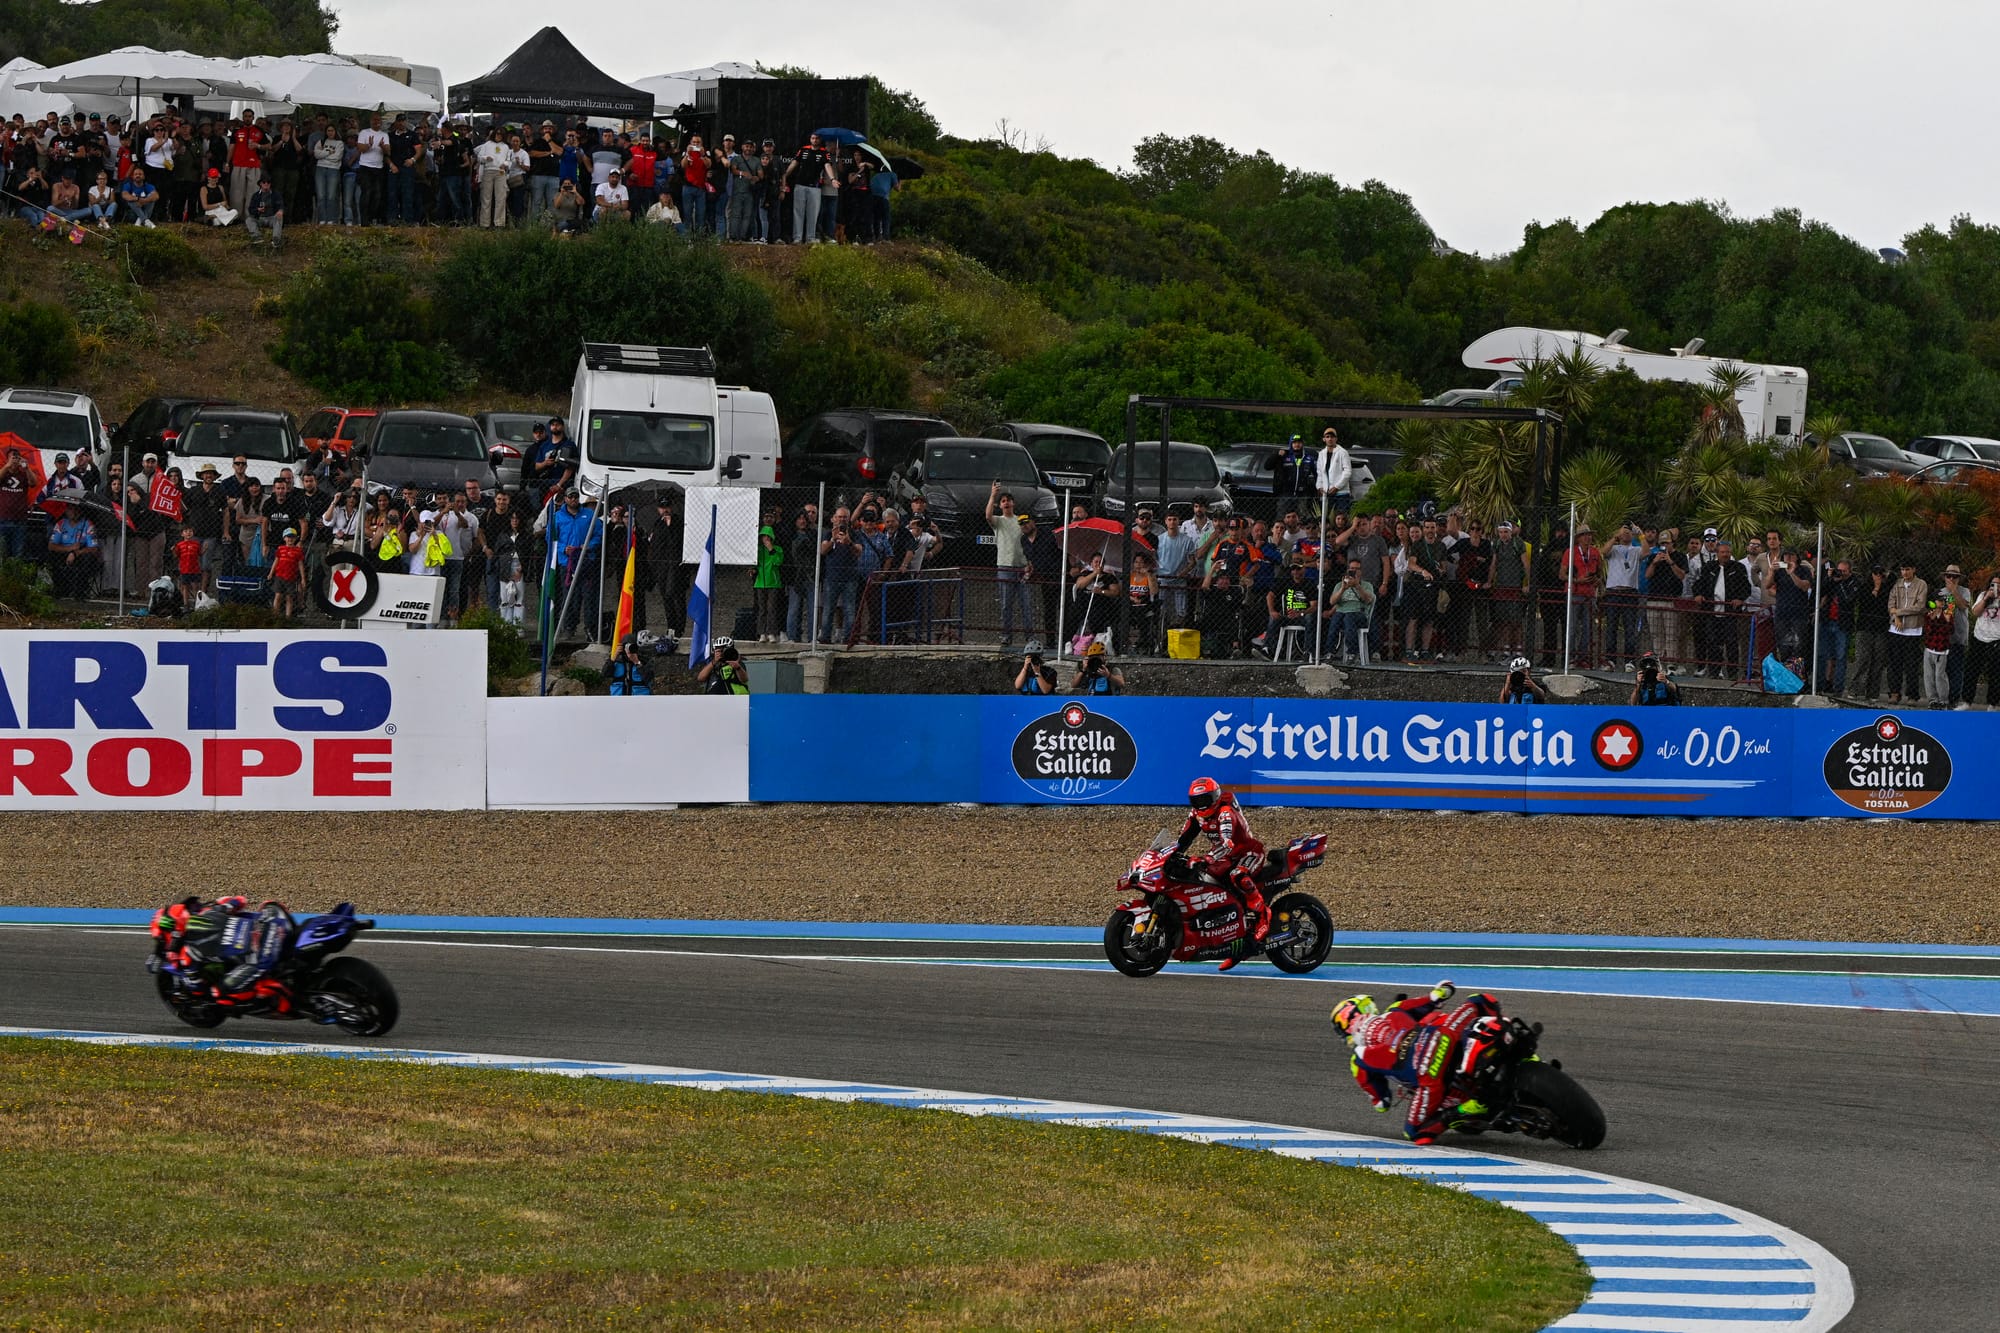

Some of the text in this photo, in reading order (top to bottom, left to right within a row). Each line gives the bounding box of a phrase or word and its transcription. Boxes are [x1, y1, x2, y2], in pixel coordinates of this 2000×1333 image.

[492, 95, 634, 111] www.embutidosgarcializana.com
[379, 609, 427, 621] LORENZO
[396, 601, 431, 610] JORGE
[0, 641, 391, 732] RTS
[1032, 729, 1116, 752] Estrella
[1200, 710, 1576, 767] Estrella Galicia
[1685, 725, 1741, 768] 0,0
[1036, 752, 1112, 775] Galicia
[1845, 742, 1929, 765] Estrella
[1061, 776, 1087, 795] 0,0
[1848, 764, 1925, 788] Galicia
[1864, 800, 1910, 809] TOSTADA
[1211, 922, 1240, 937] NetApp
